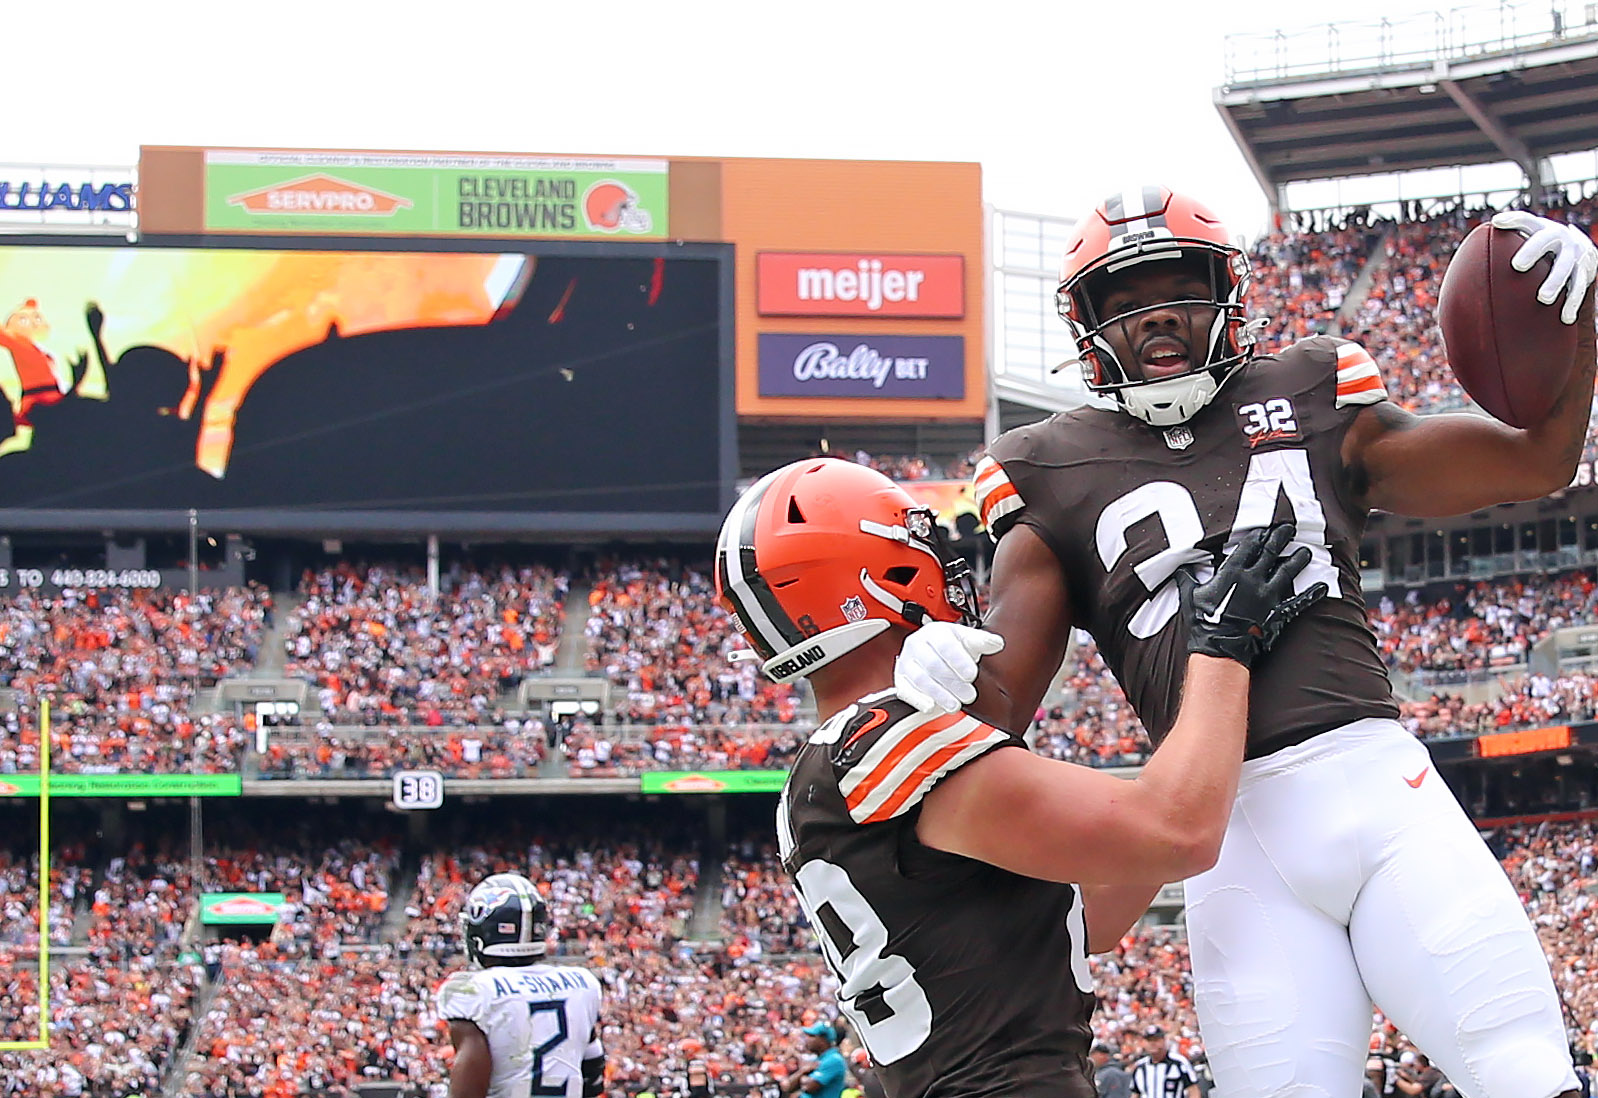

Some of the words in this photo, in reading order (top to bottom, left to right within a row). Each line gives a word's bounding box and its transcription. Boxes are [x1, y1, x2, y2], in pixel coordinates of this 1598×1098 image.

[266, 190, 376, 211] SERVPRO
[458, 176, 576, 201] CLEVELAND
[458, 202, 576, 230] BROWNS
[797, 259, 924, 310] meijer
[793, 342, 892, 388] Bally
[894, 358, 929, 380] BET
[1238, 398, 1297, 435] 32
[1096, 448, 1343, 640] 24
[16, 569, 44, 588] TO
[401, 776, 436, 804] 38
[529, 1000, 569, 1097] 2
